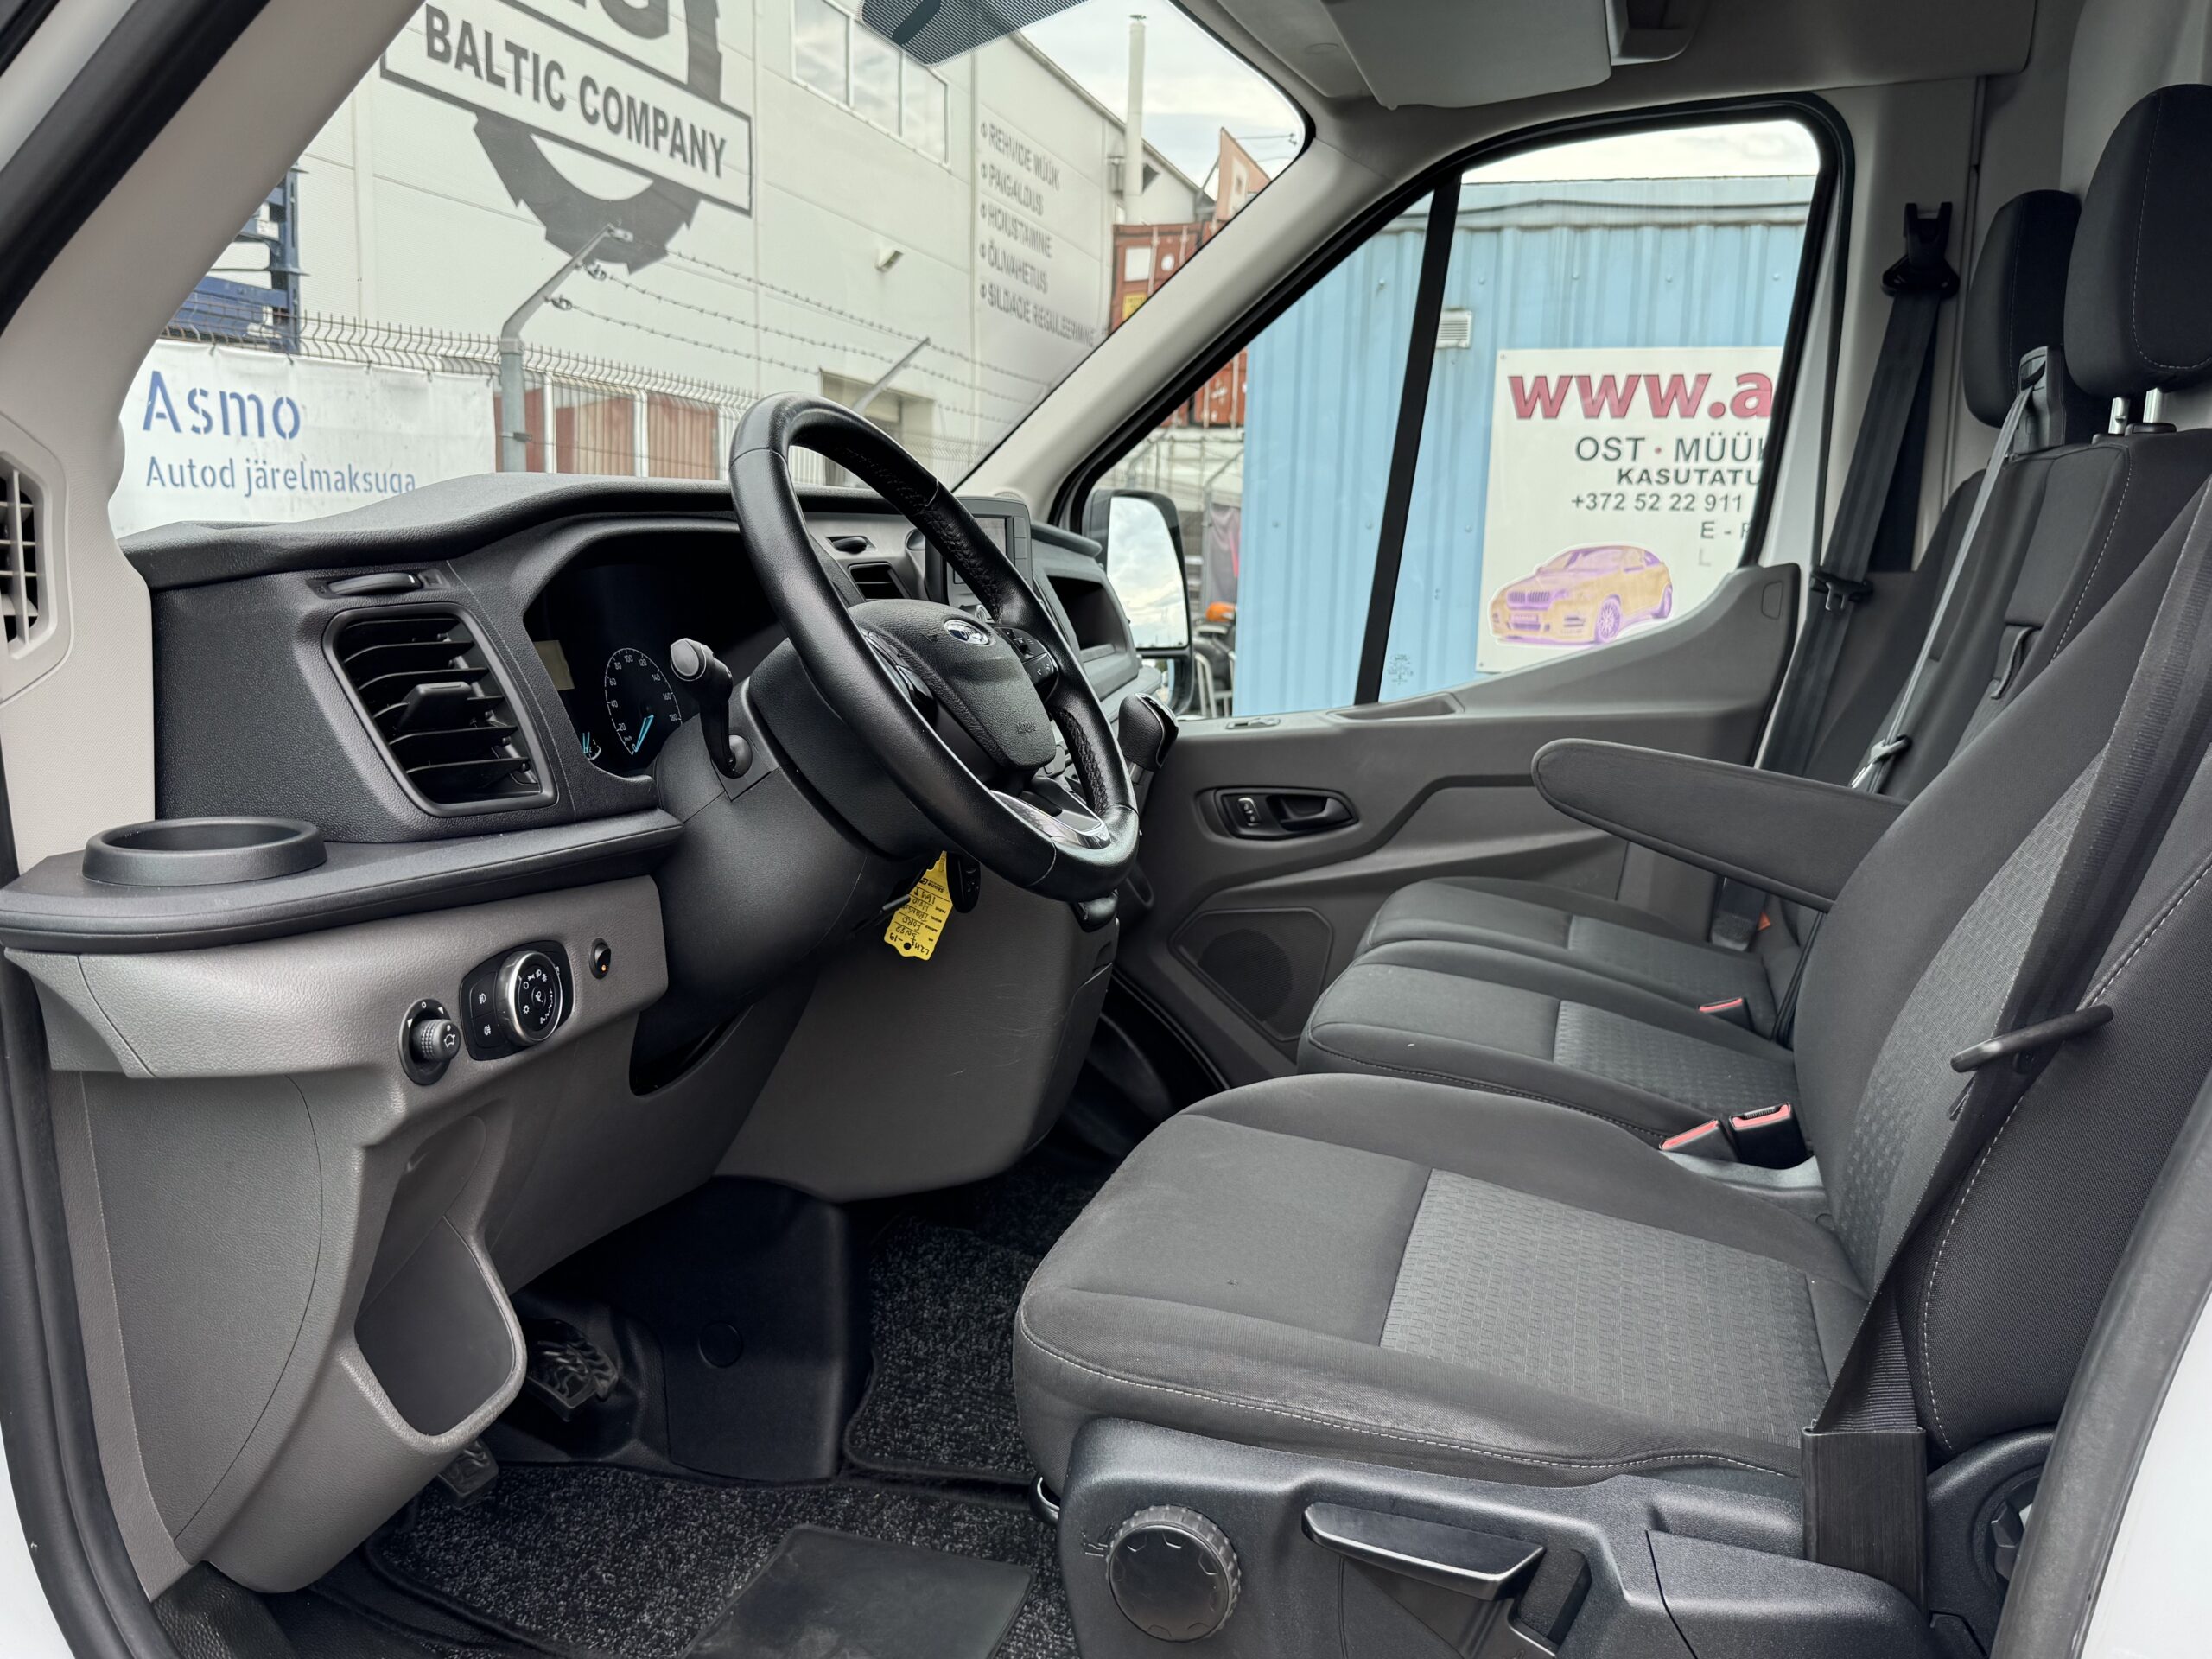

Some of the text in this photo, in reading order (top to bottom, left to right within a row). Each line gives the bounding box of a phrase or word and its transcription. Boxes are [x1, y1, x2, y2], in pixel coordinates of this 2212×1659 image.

[425, 3, 727, 178] BALTIC COMPANY
[143, 370, 301, 440] Asmo
[1575, 436, 1645, 462] OST
[146, 455, 416, 498] Autod järelmaksuga
[1571, 493, 1742, 512] +372 52 22 911
[1700, 521, 1714, 539] E
[614, 662, 622, 671] 80
[624, 654, 633, 664] 100
[638, 658, 647, 667] 120
[609, 677, 616, 686] 60
[652, 673, 661, 682] 140
